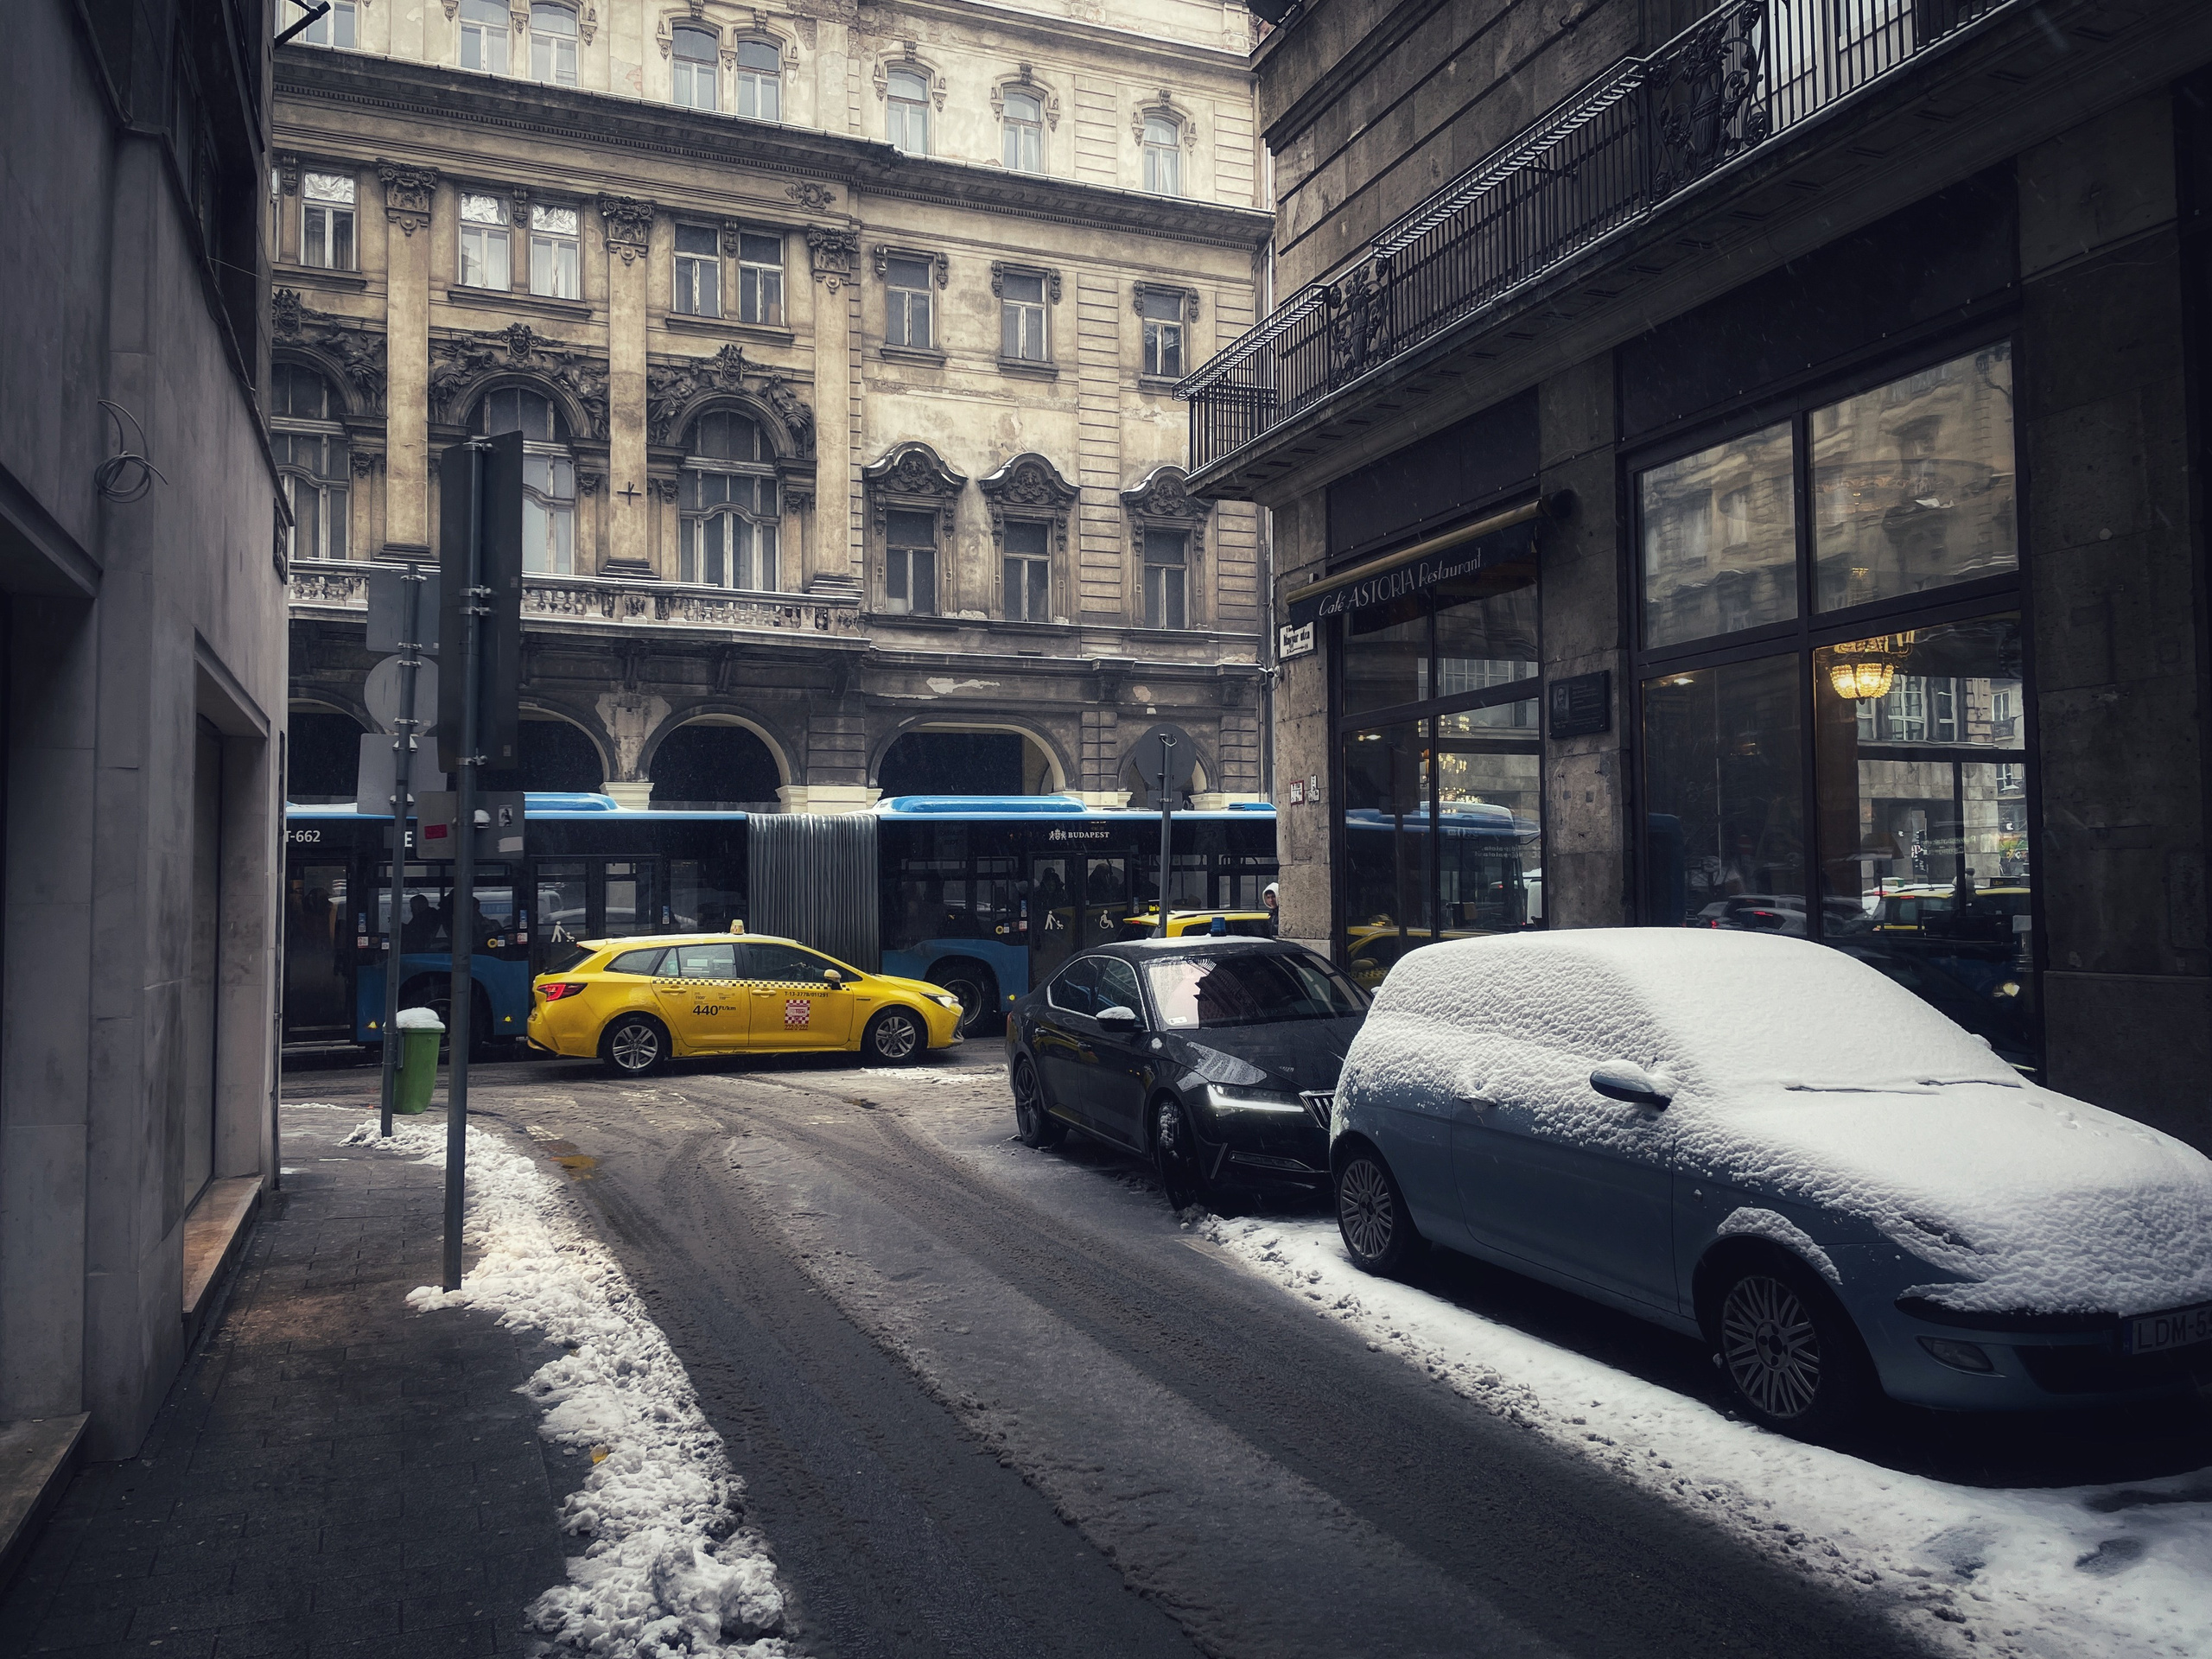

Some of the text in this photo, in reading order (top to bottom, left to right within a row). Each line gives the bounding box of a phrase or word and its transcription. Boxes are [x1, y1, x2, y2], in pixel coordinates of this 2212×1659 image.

[1319, 547, 1482, 616] Café ASTORIA Restaurant
[692, 1005, 718, 1015] 440
